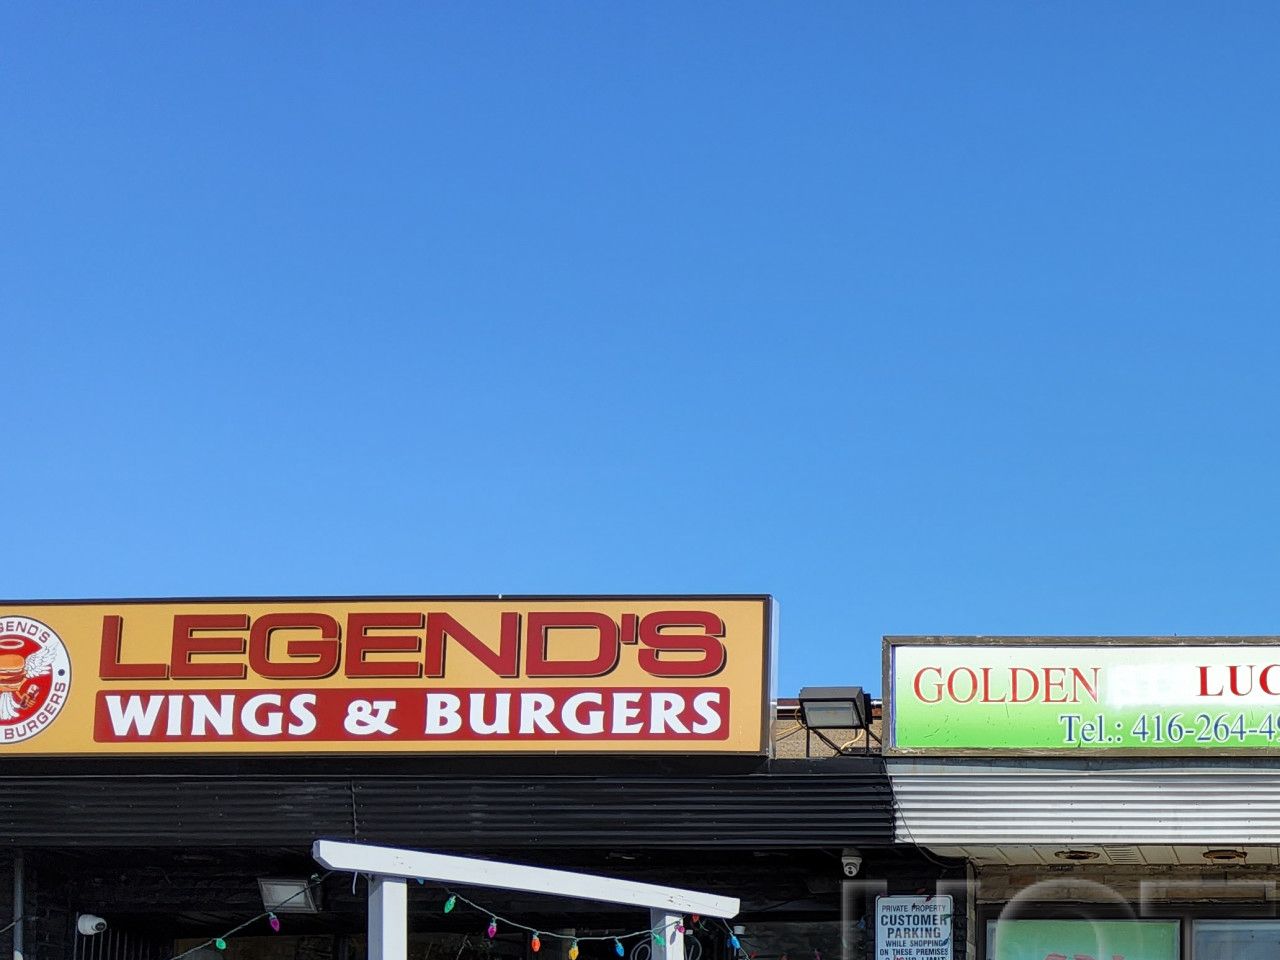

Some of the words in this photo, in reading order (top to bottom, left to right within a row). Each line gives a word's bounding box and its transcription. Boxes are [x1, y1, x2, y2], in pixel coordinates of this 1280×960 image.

[0, 621, 50, 643] END'S
[99, 611, 727, 680] LEGEND'S
[913, 666, 1100, 703] GOLDEN
[4, 682, 66, 739] BURGERS
[105, 694, 317, 736] WINGS
[344, 699, 398, 736] &
[424, 692, 721, 735] BURGERS
[1060, 715, 1122, 742] Tel.:
[881, 914, 947, 926] CUSTOMER
[882, 904, 908, 912] PRIVATE
[912, 904, 946, 912] PROPERTY
[887, 927, 941, 938] PARKING
